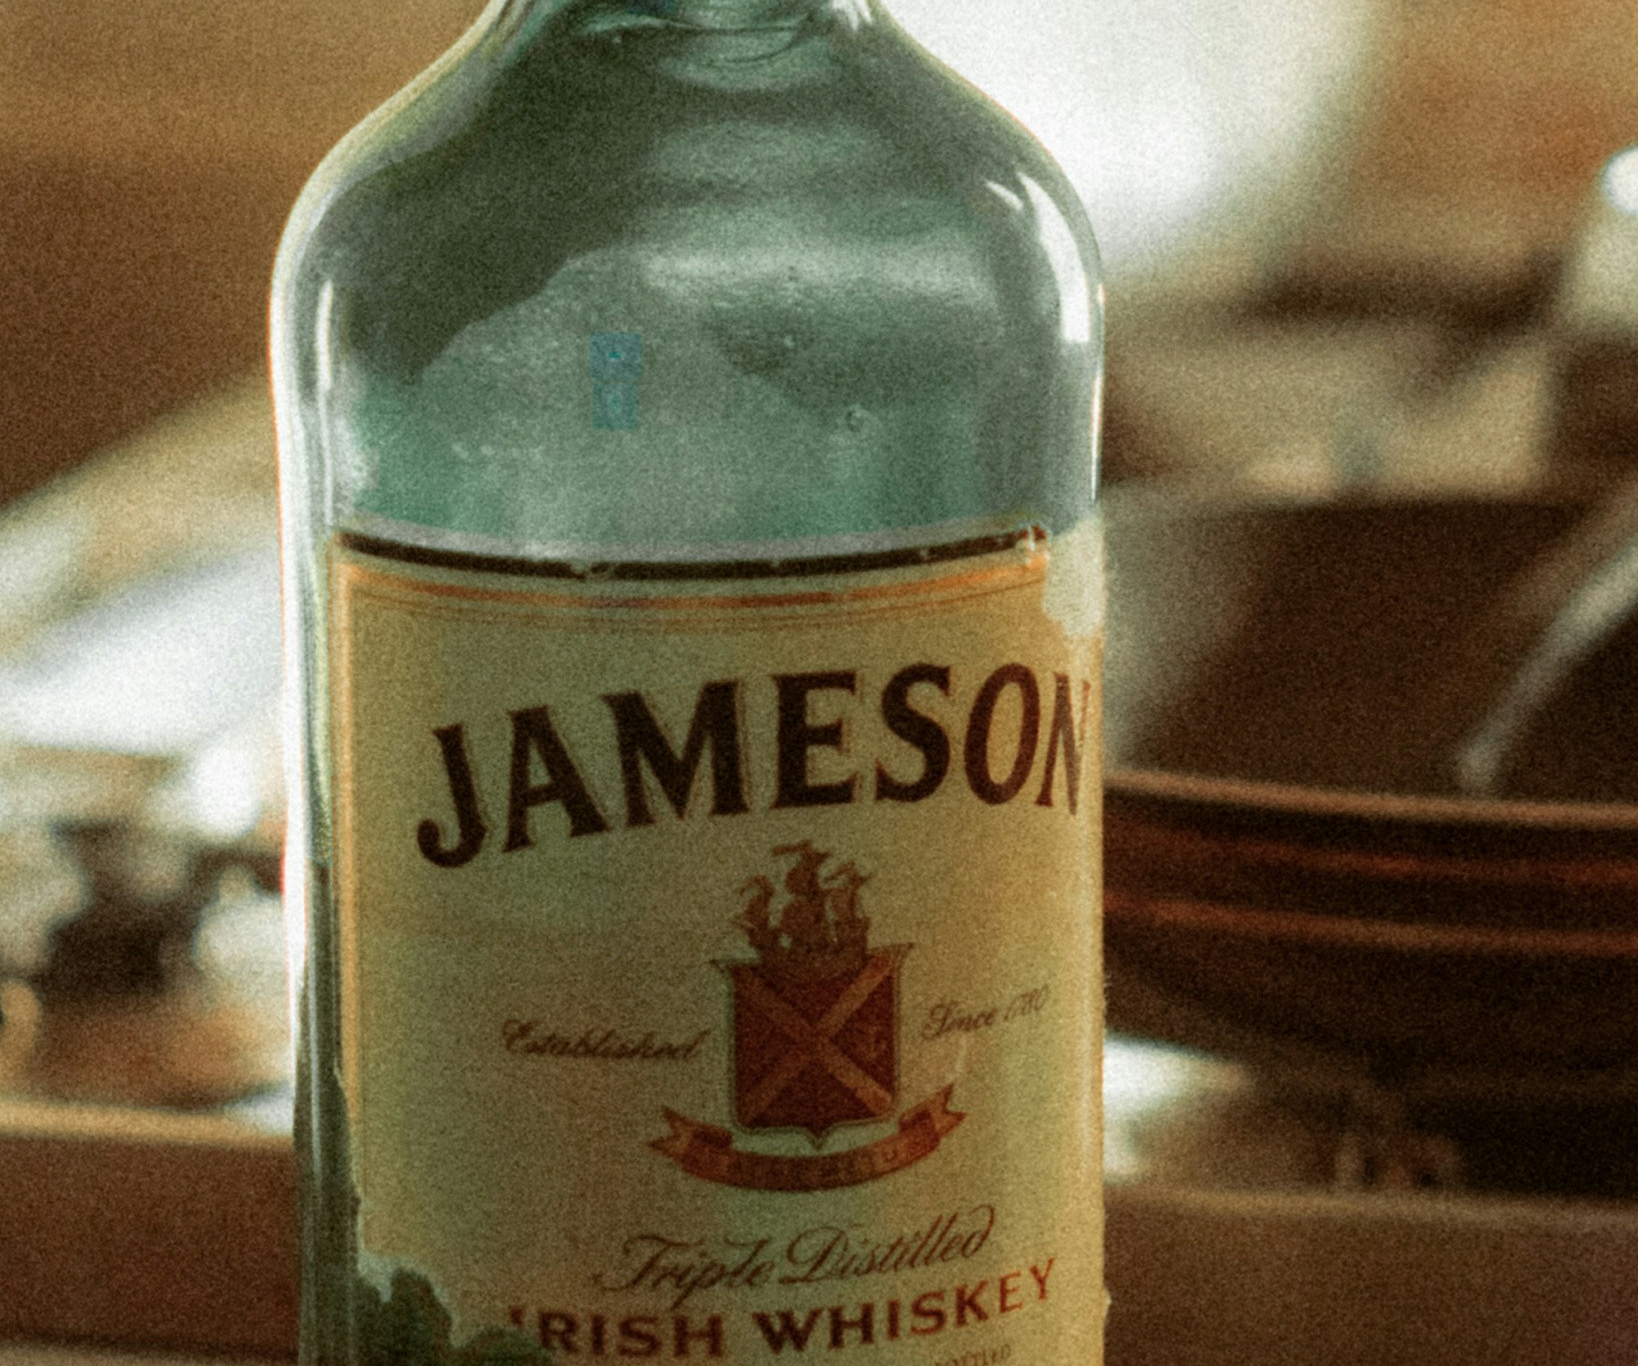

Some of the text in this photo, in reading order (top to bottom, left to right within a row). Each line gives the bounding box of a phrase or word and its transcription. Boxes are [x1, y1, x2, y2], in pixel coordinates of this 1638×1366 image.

[417, 661, 1091, 868] JAMESON
[594, 1203, 998, 1312] Triple Distilled
[751, 1257, 1057, 1357] WHISKEY
